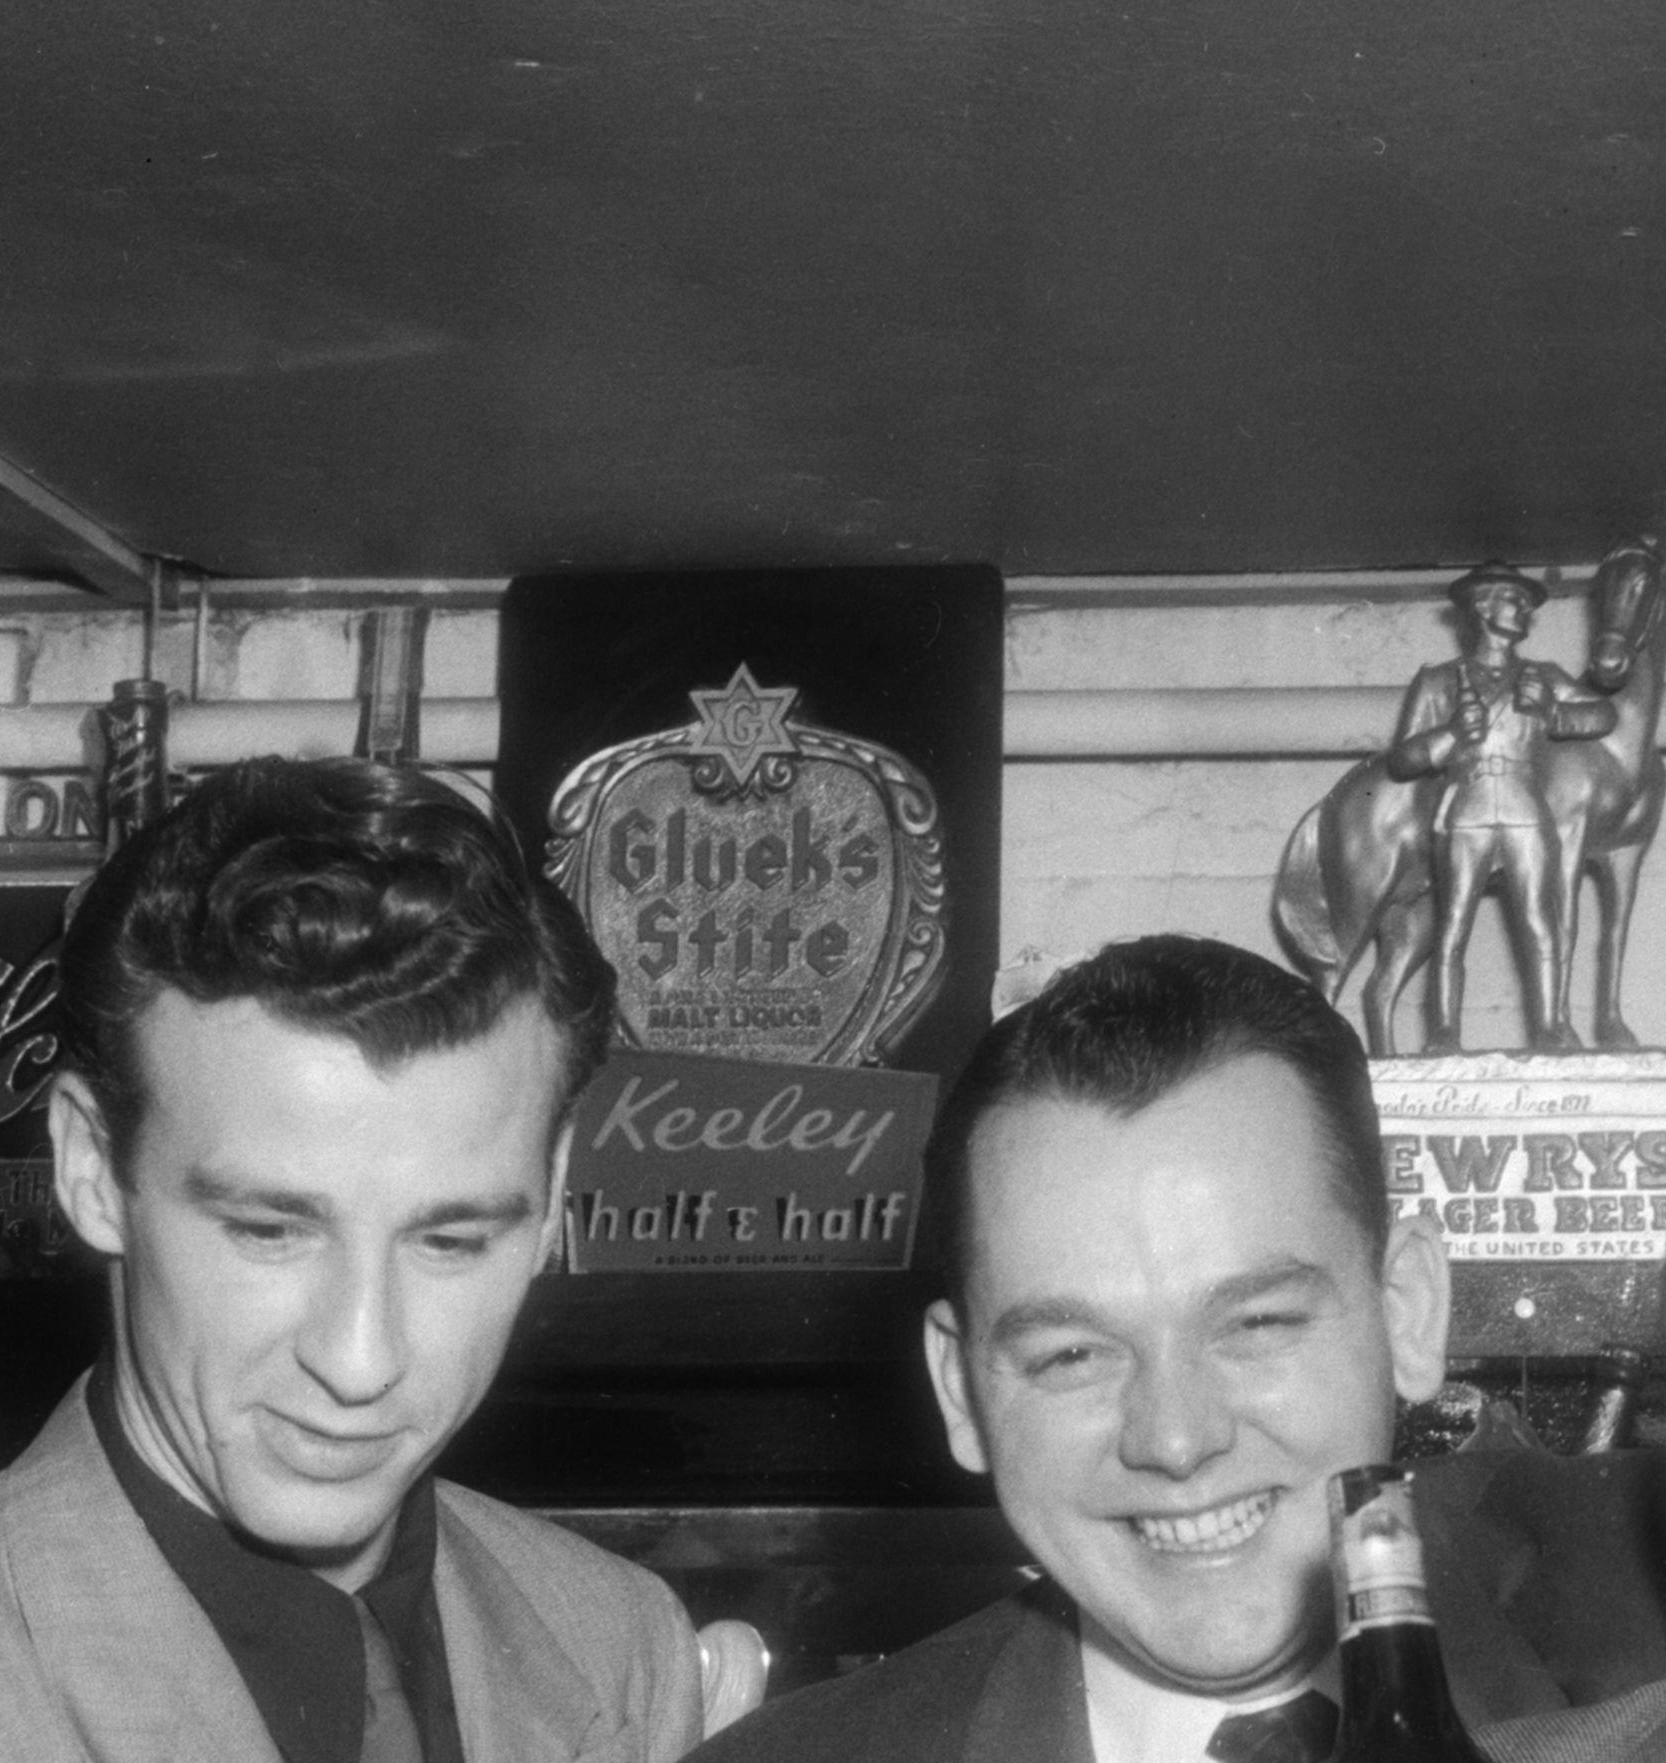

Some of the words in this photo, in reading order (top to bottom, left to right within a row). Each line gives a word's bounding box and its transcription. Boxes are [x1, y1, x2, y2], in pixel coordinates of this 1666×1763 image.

[635, 898, 851, 984] Stite
[648, 1006, 721, 1029] MALT
[728, 1005, 823, 1028] LIQUOR
[590, 1073, 896, 1177] Keeley
[584, 1188, 719, 1244] half
[779, 1189, 909, 1244] half
[1485, 1239, 1565, 1257] UNITED
[1575, 1239, 1655, 1257] STATES
